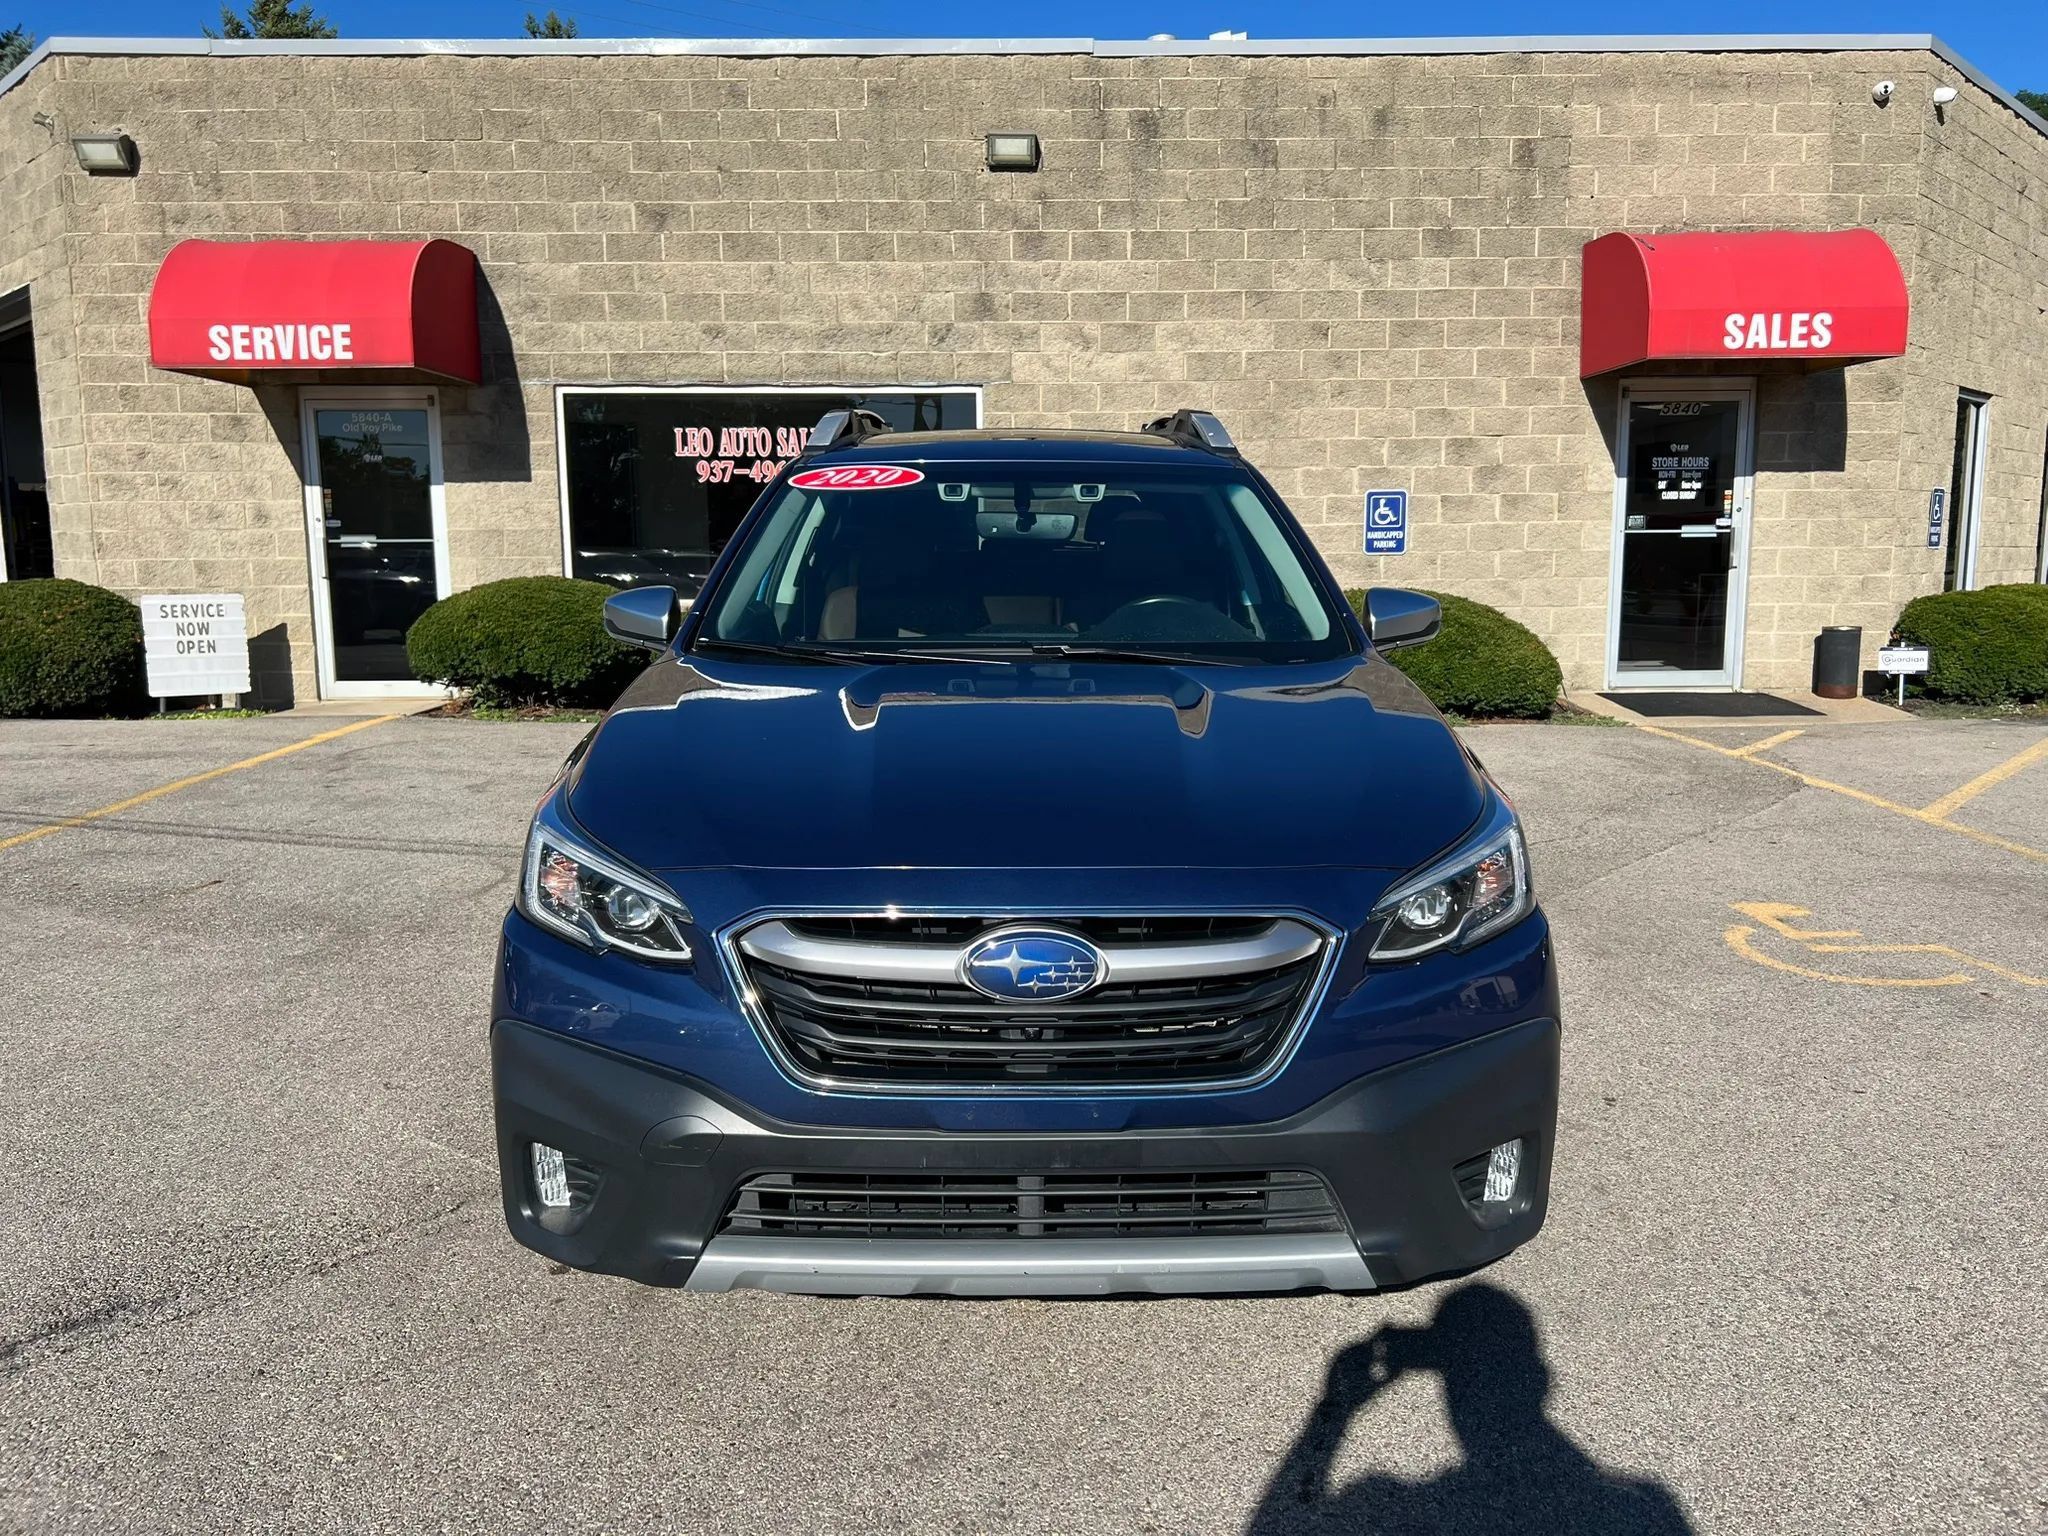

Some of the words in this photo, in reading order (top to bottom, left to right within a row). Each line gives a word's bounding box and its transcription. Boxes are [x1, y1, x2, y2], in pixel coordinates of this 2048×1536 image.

[1723, 312, 1833, 350] SALES
[208, 324, 354, 361] SERVICE
[1662, 403, 1701, 414] 5840
[351, 412, 392, 422] 5840-A
[342, 423, 359, 432] Old
[360, 423, 380, 434] Troy
[382, 423, 403, 432] Pike
[674, 426, 714, 458] LEO
[718, 426, 772, 458] AUTO
[776, 426, 815, 458] SAL
[1652, 457, 1679, 467] STORE
[1681, 457, 1709, 467] HOURS
[809, 469, 903, 486] 2020
[1367, 531, 1403, 539] HANDICAPPED
[1373, 540, 1397, 548] PARKING
[160, 604, 224, 618] SERVICE
[176, 622, 210, 637] NOW
[176, 640, 217, 654] OPEN
[1885, 656, 1925, 664] Guardian
